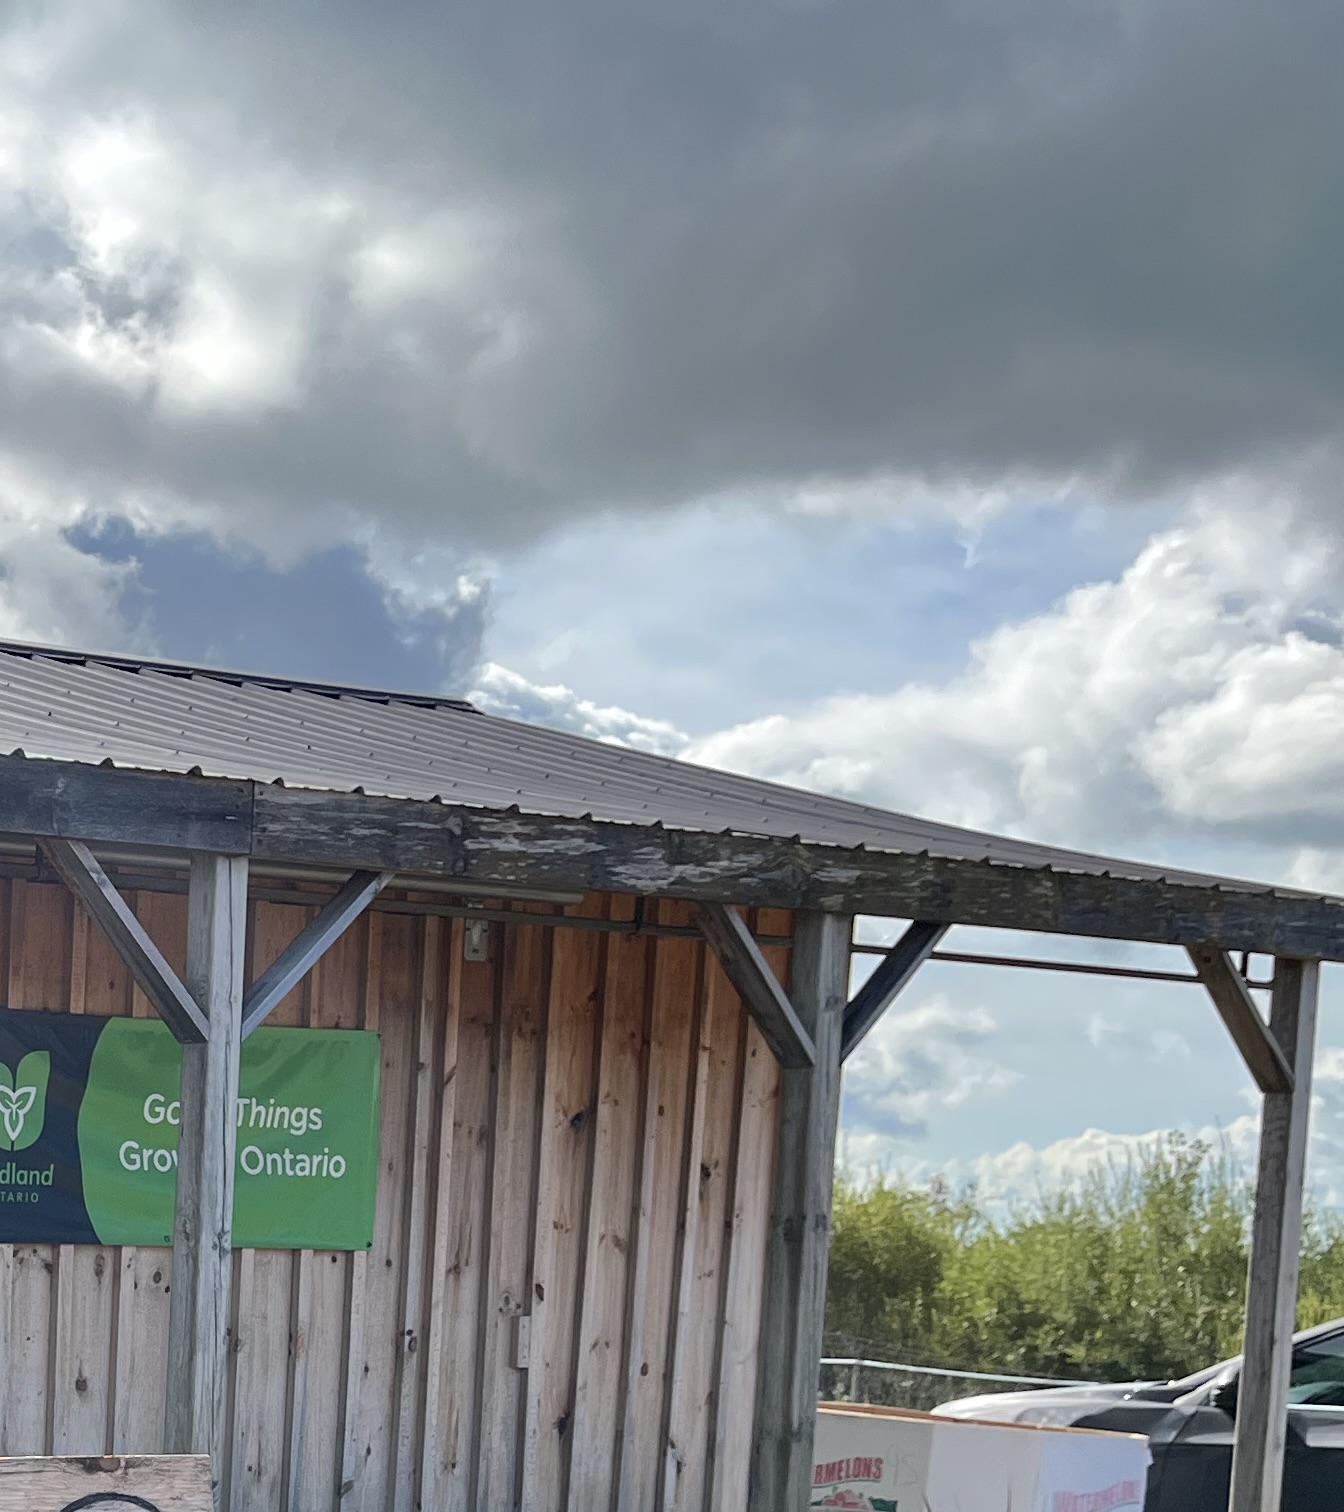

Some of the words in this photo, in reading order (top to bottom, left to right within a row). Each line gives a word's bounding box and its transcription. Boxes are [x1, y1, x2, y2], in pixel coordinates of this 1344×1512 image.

[143, 1093, 180, 1126] Go
[236, 1098, 323, 1136] Things
[240, 1145, 346, 1179] Ontario
[814, 1457, 883, 1485] RMELONS
